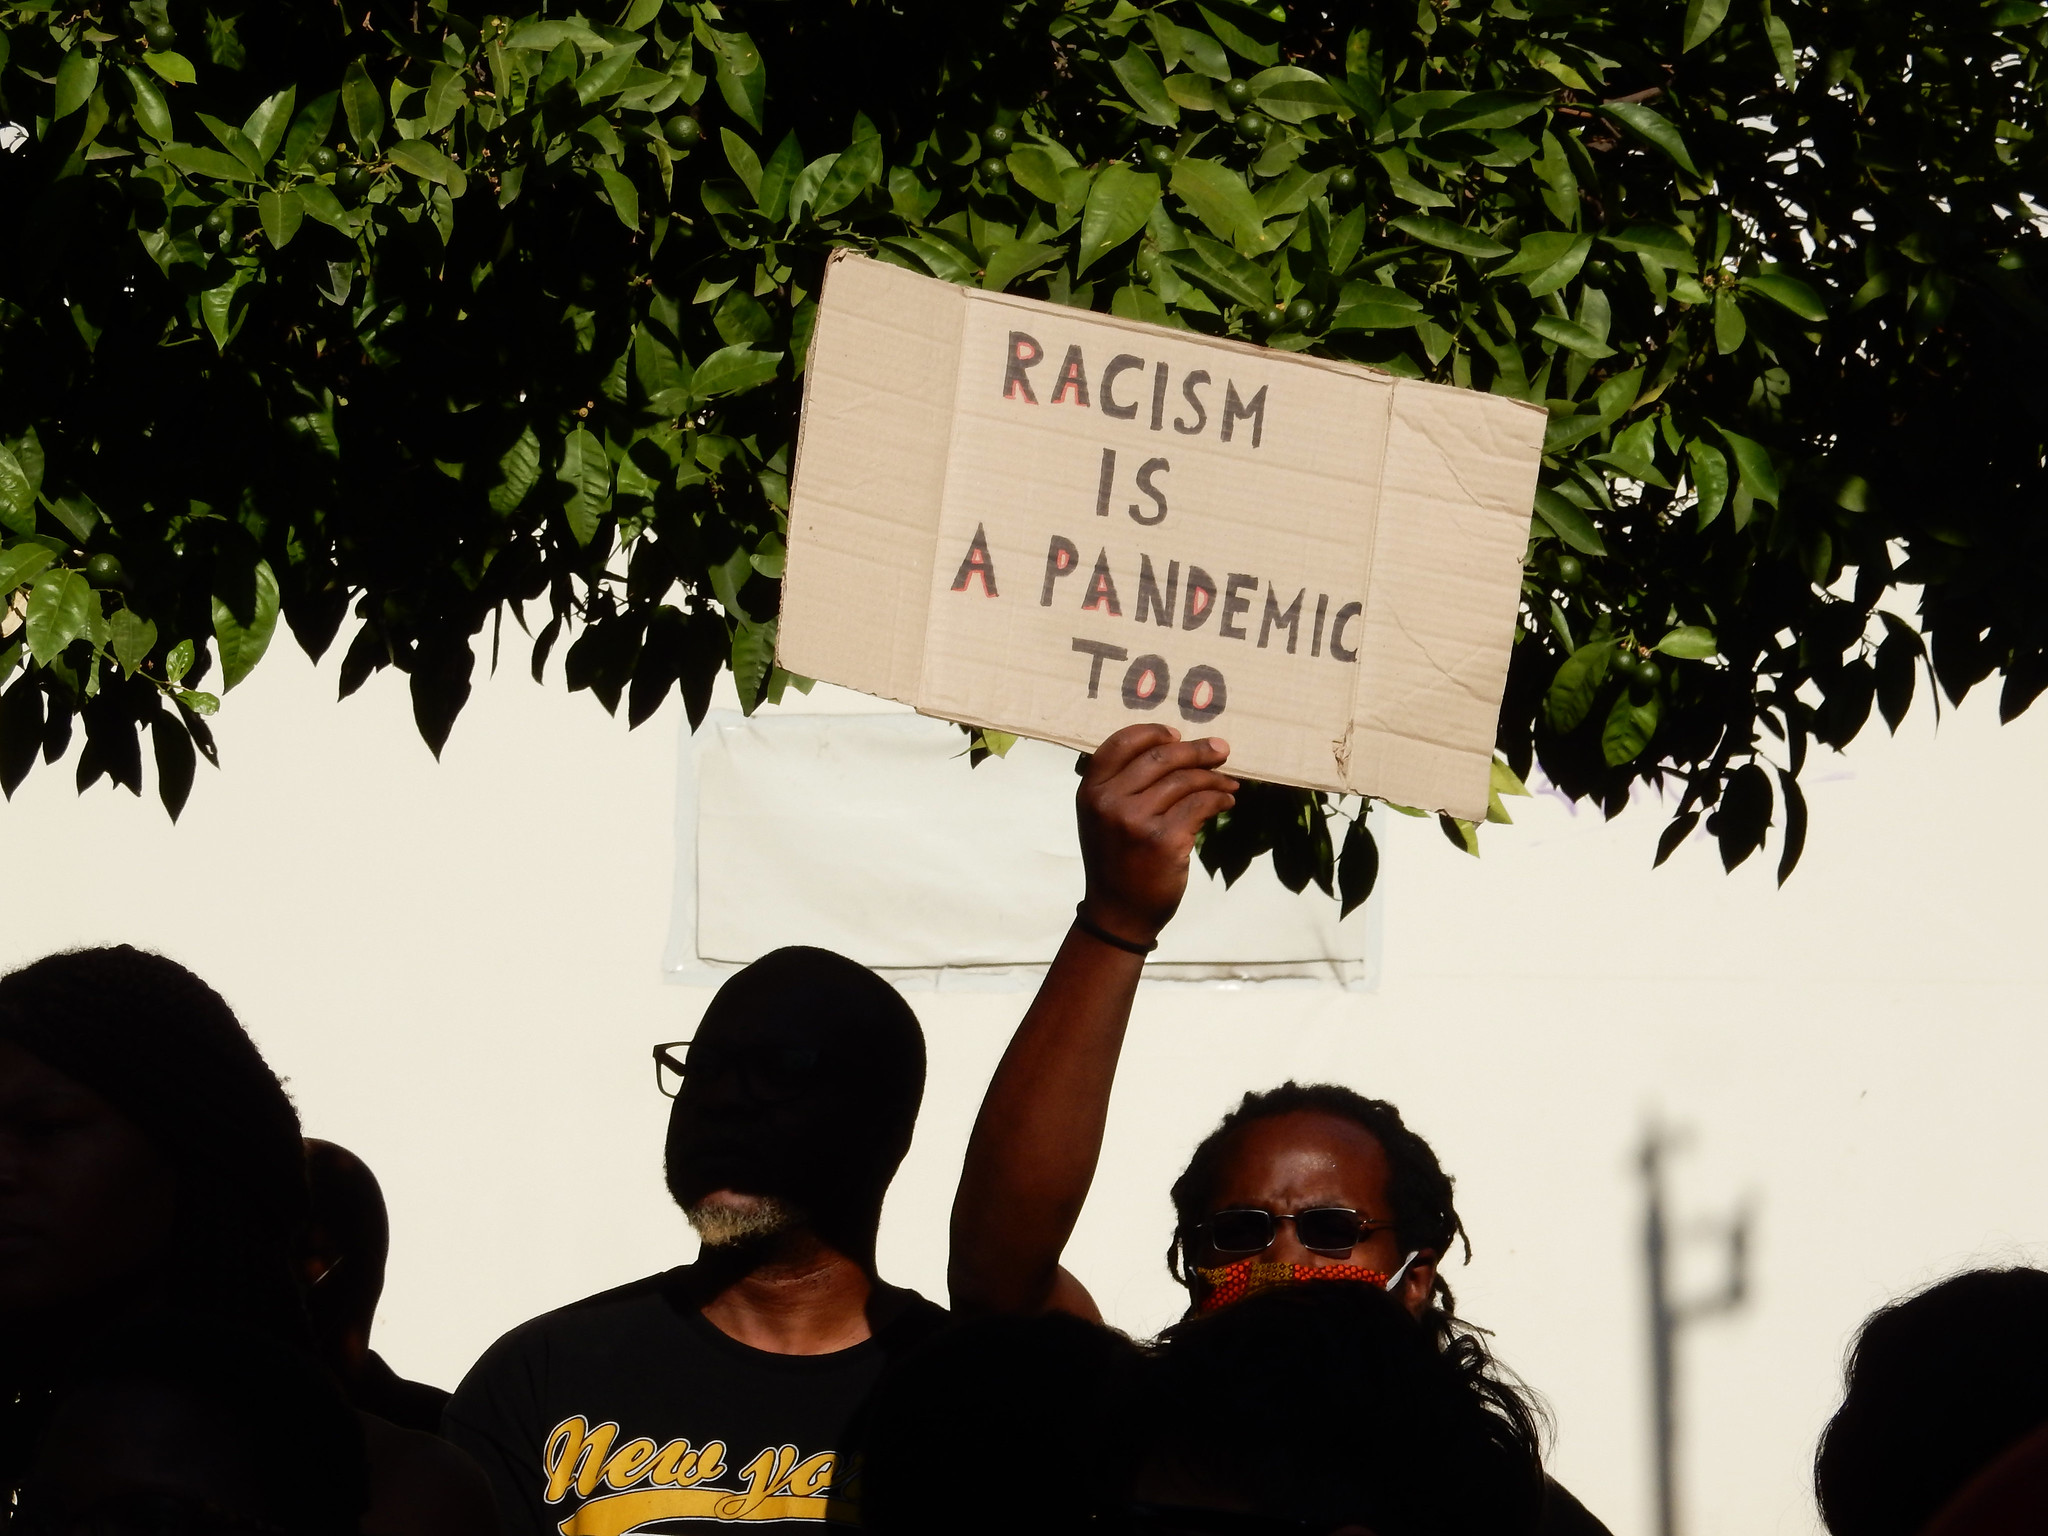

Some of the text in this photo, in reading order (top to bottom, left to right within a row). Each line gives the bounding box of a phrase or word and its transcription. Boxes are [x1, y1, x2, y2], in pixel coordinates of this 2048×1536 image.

[1002, 330, 1270, 448] RACISM
[1096, 447, 1170, 526] IS
[950, 522, 1364, 663] A PANDEMIC
[1071, 637, 1227, 724] TOO
[543, 1414, 728, 1504] New
